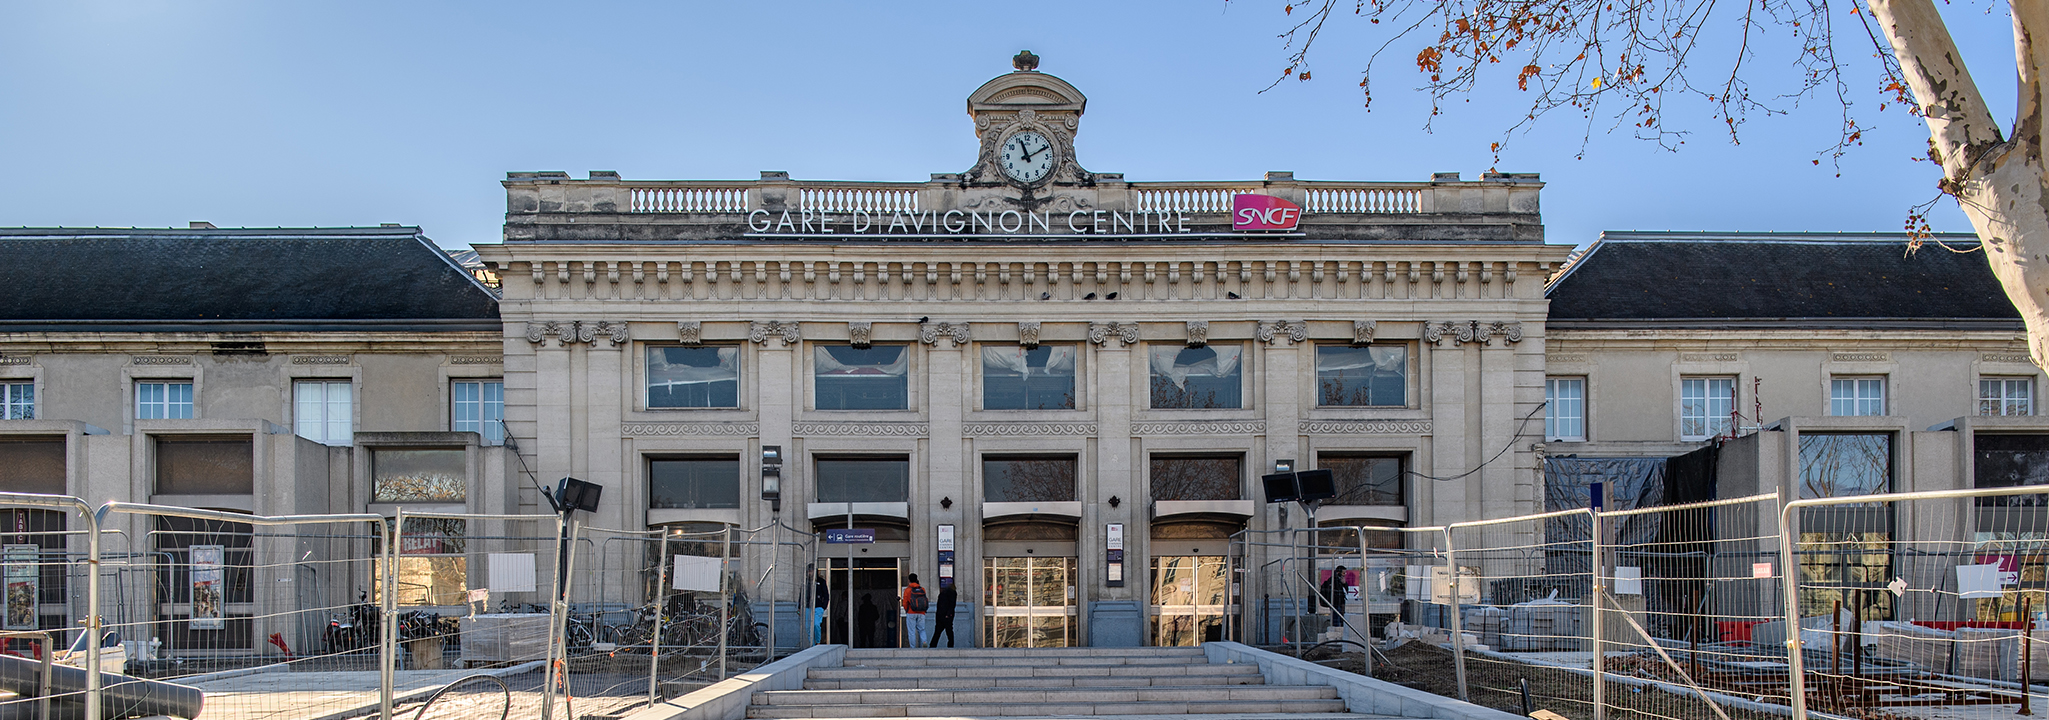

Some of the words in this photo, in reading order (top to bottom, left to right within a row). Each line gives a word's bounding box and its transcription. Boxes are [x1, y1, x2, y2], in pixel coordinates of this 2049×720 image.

[748, 208, 834, 233] GARE
[853, 208, 1049, 233] D'AVIGNON
[1068, 208, 1191, 233] CENTRE
[1235, 207, 1299, 227] SNCF
[404, 532, 438, 551] RELAY
